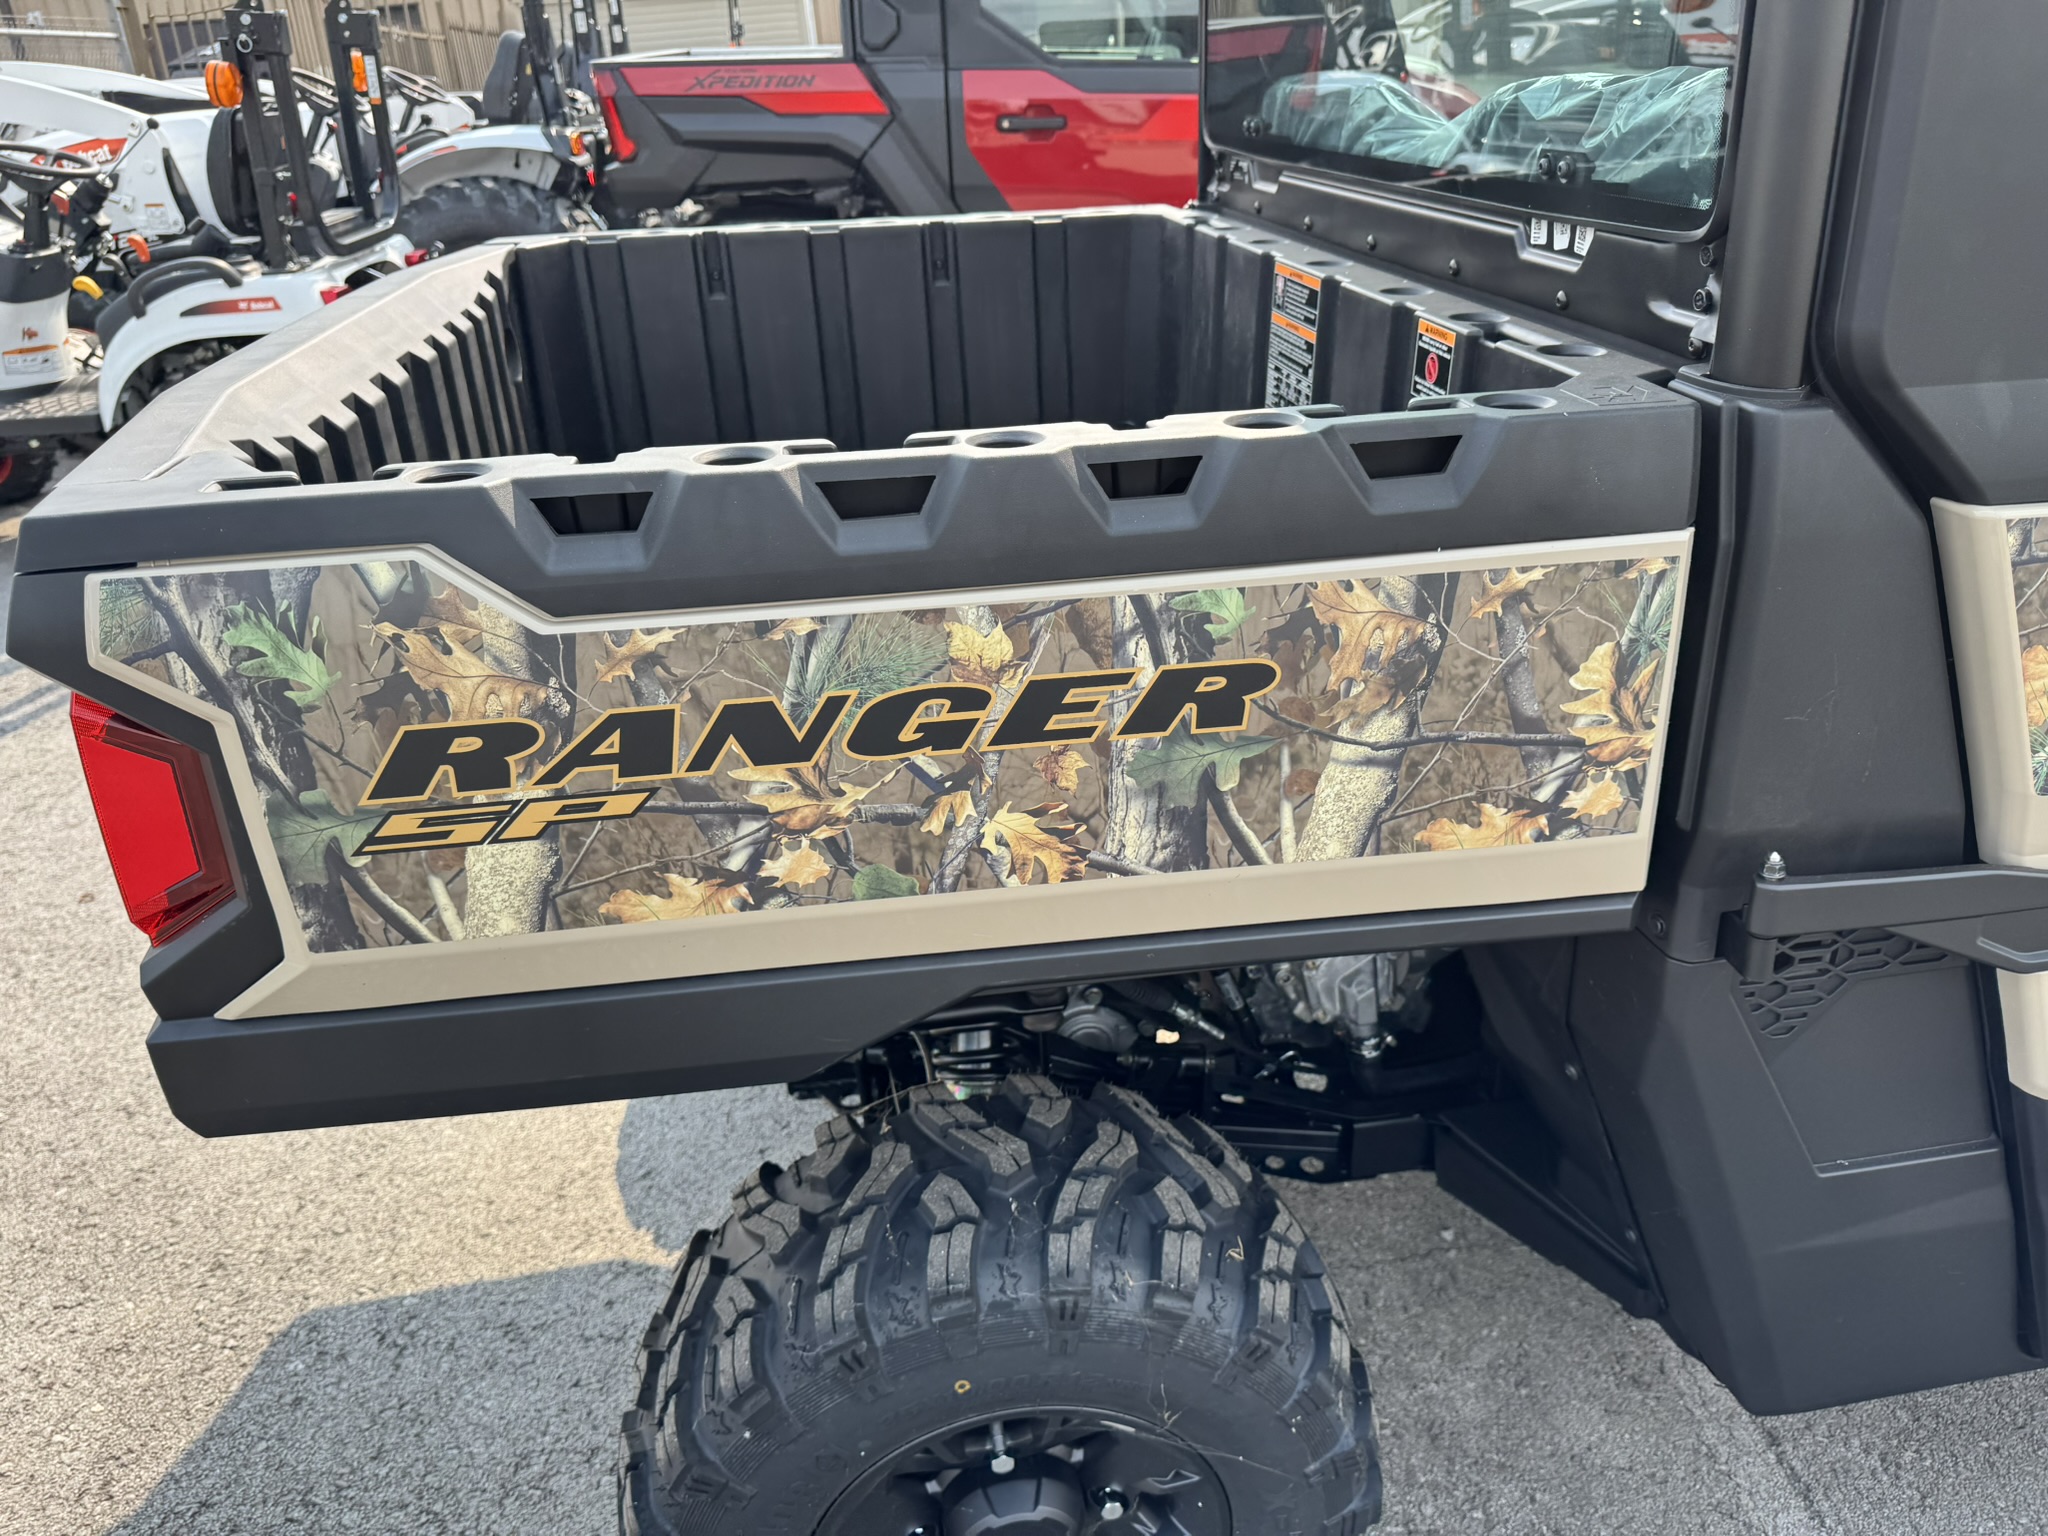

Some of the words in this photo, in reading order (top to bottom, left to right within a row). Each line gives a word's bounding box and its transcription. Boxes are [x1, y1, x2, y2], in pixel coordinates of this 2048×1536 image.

[684, 69, 816, 93] XPEDITION
[358, 658, 1282, 806] RANGER
[352, 787, 660, 856] SP
